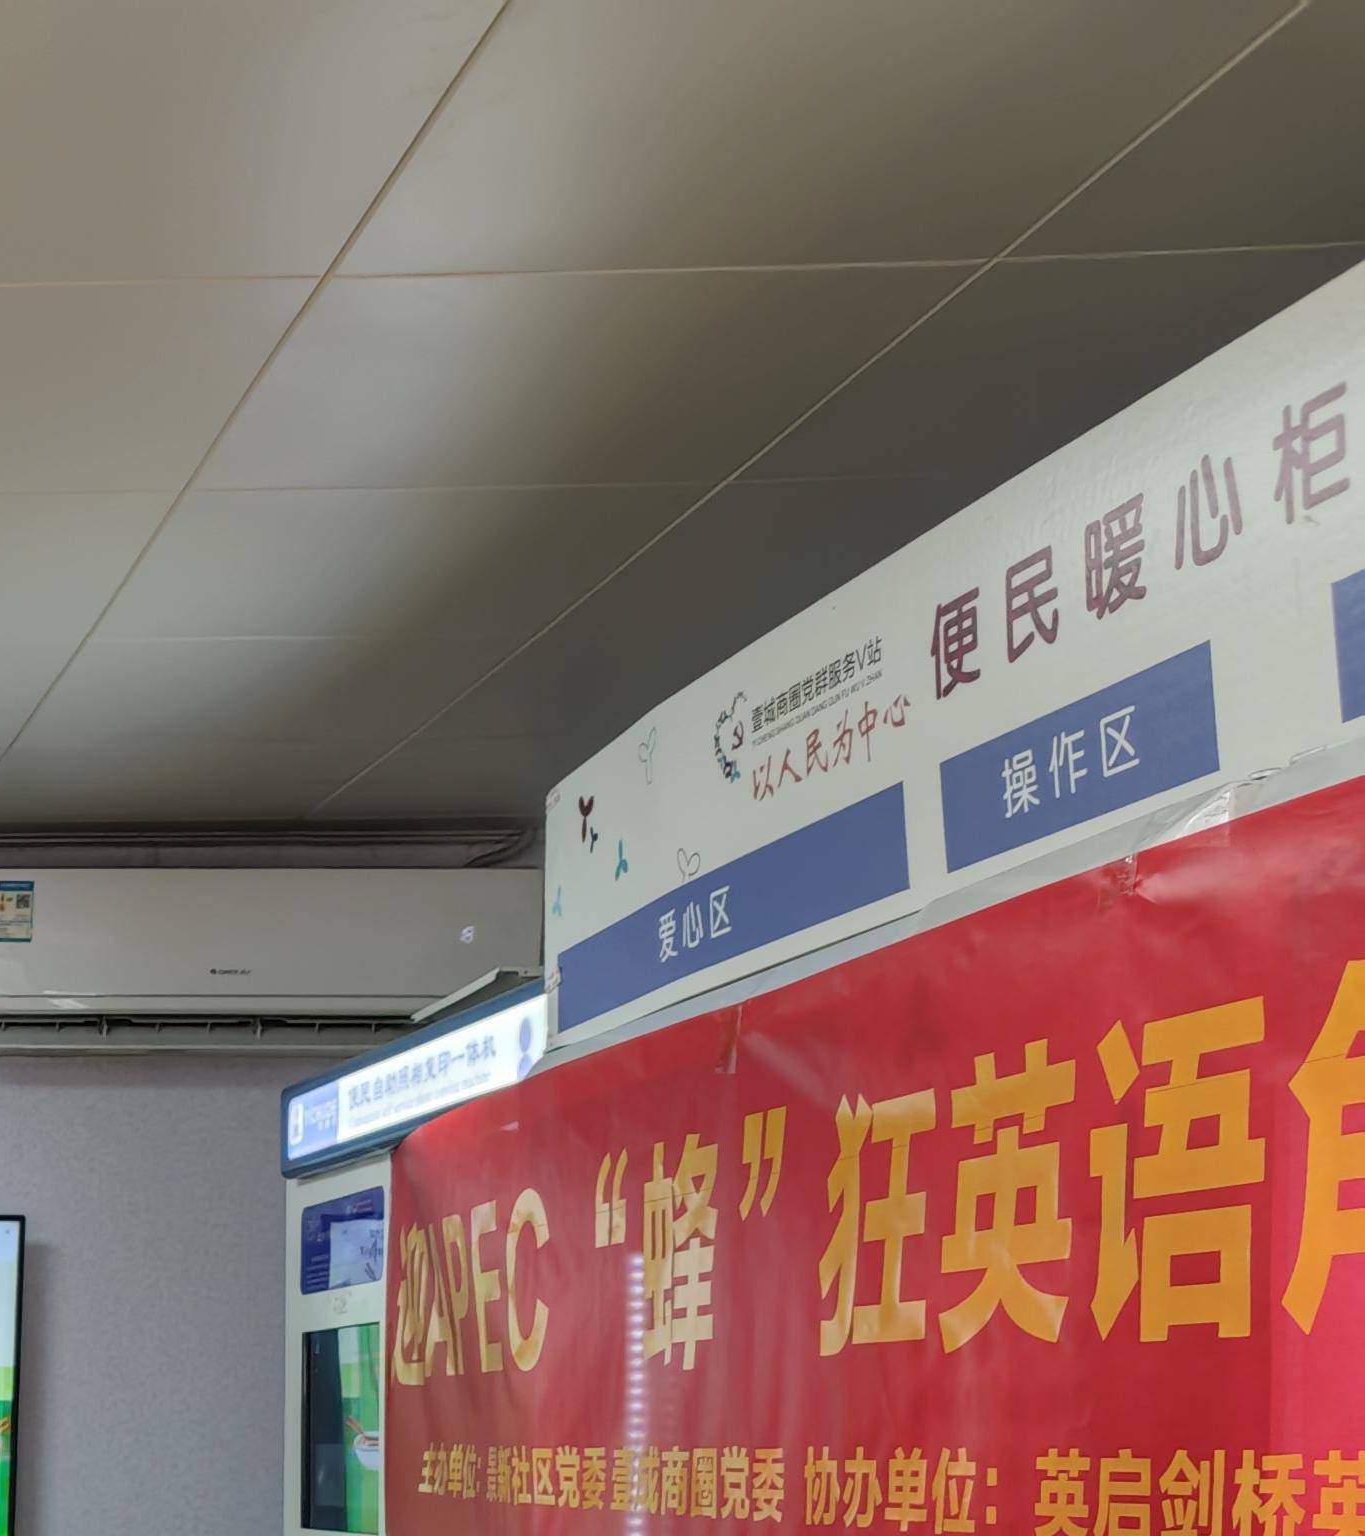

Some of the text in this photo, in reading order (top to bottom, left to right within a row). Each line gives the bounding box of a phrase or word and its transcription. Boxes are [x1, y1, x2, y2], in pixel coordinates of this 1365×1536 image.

[930, 381, 1350, 700] 便民暖心柜
[752, 636, 883, 733] 壹城商圈党群服务V站
[753, 694, 911, 801] 以人民为中心
[1002, 705, 1140, 819] 操作区
[658, 885, 733, 964] 爱心区
